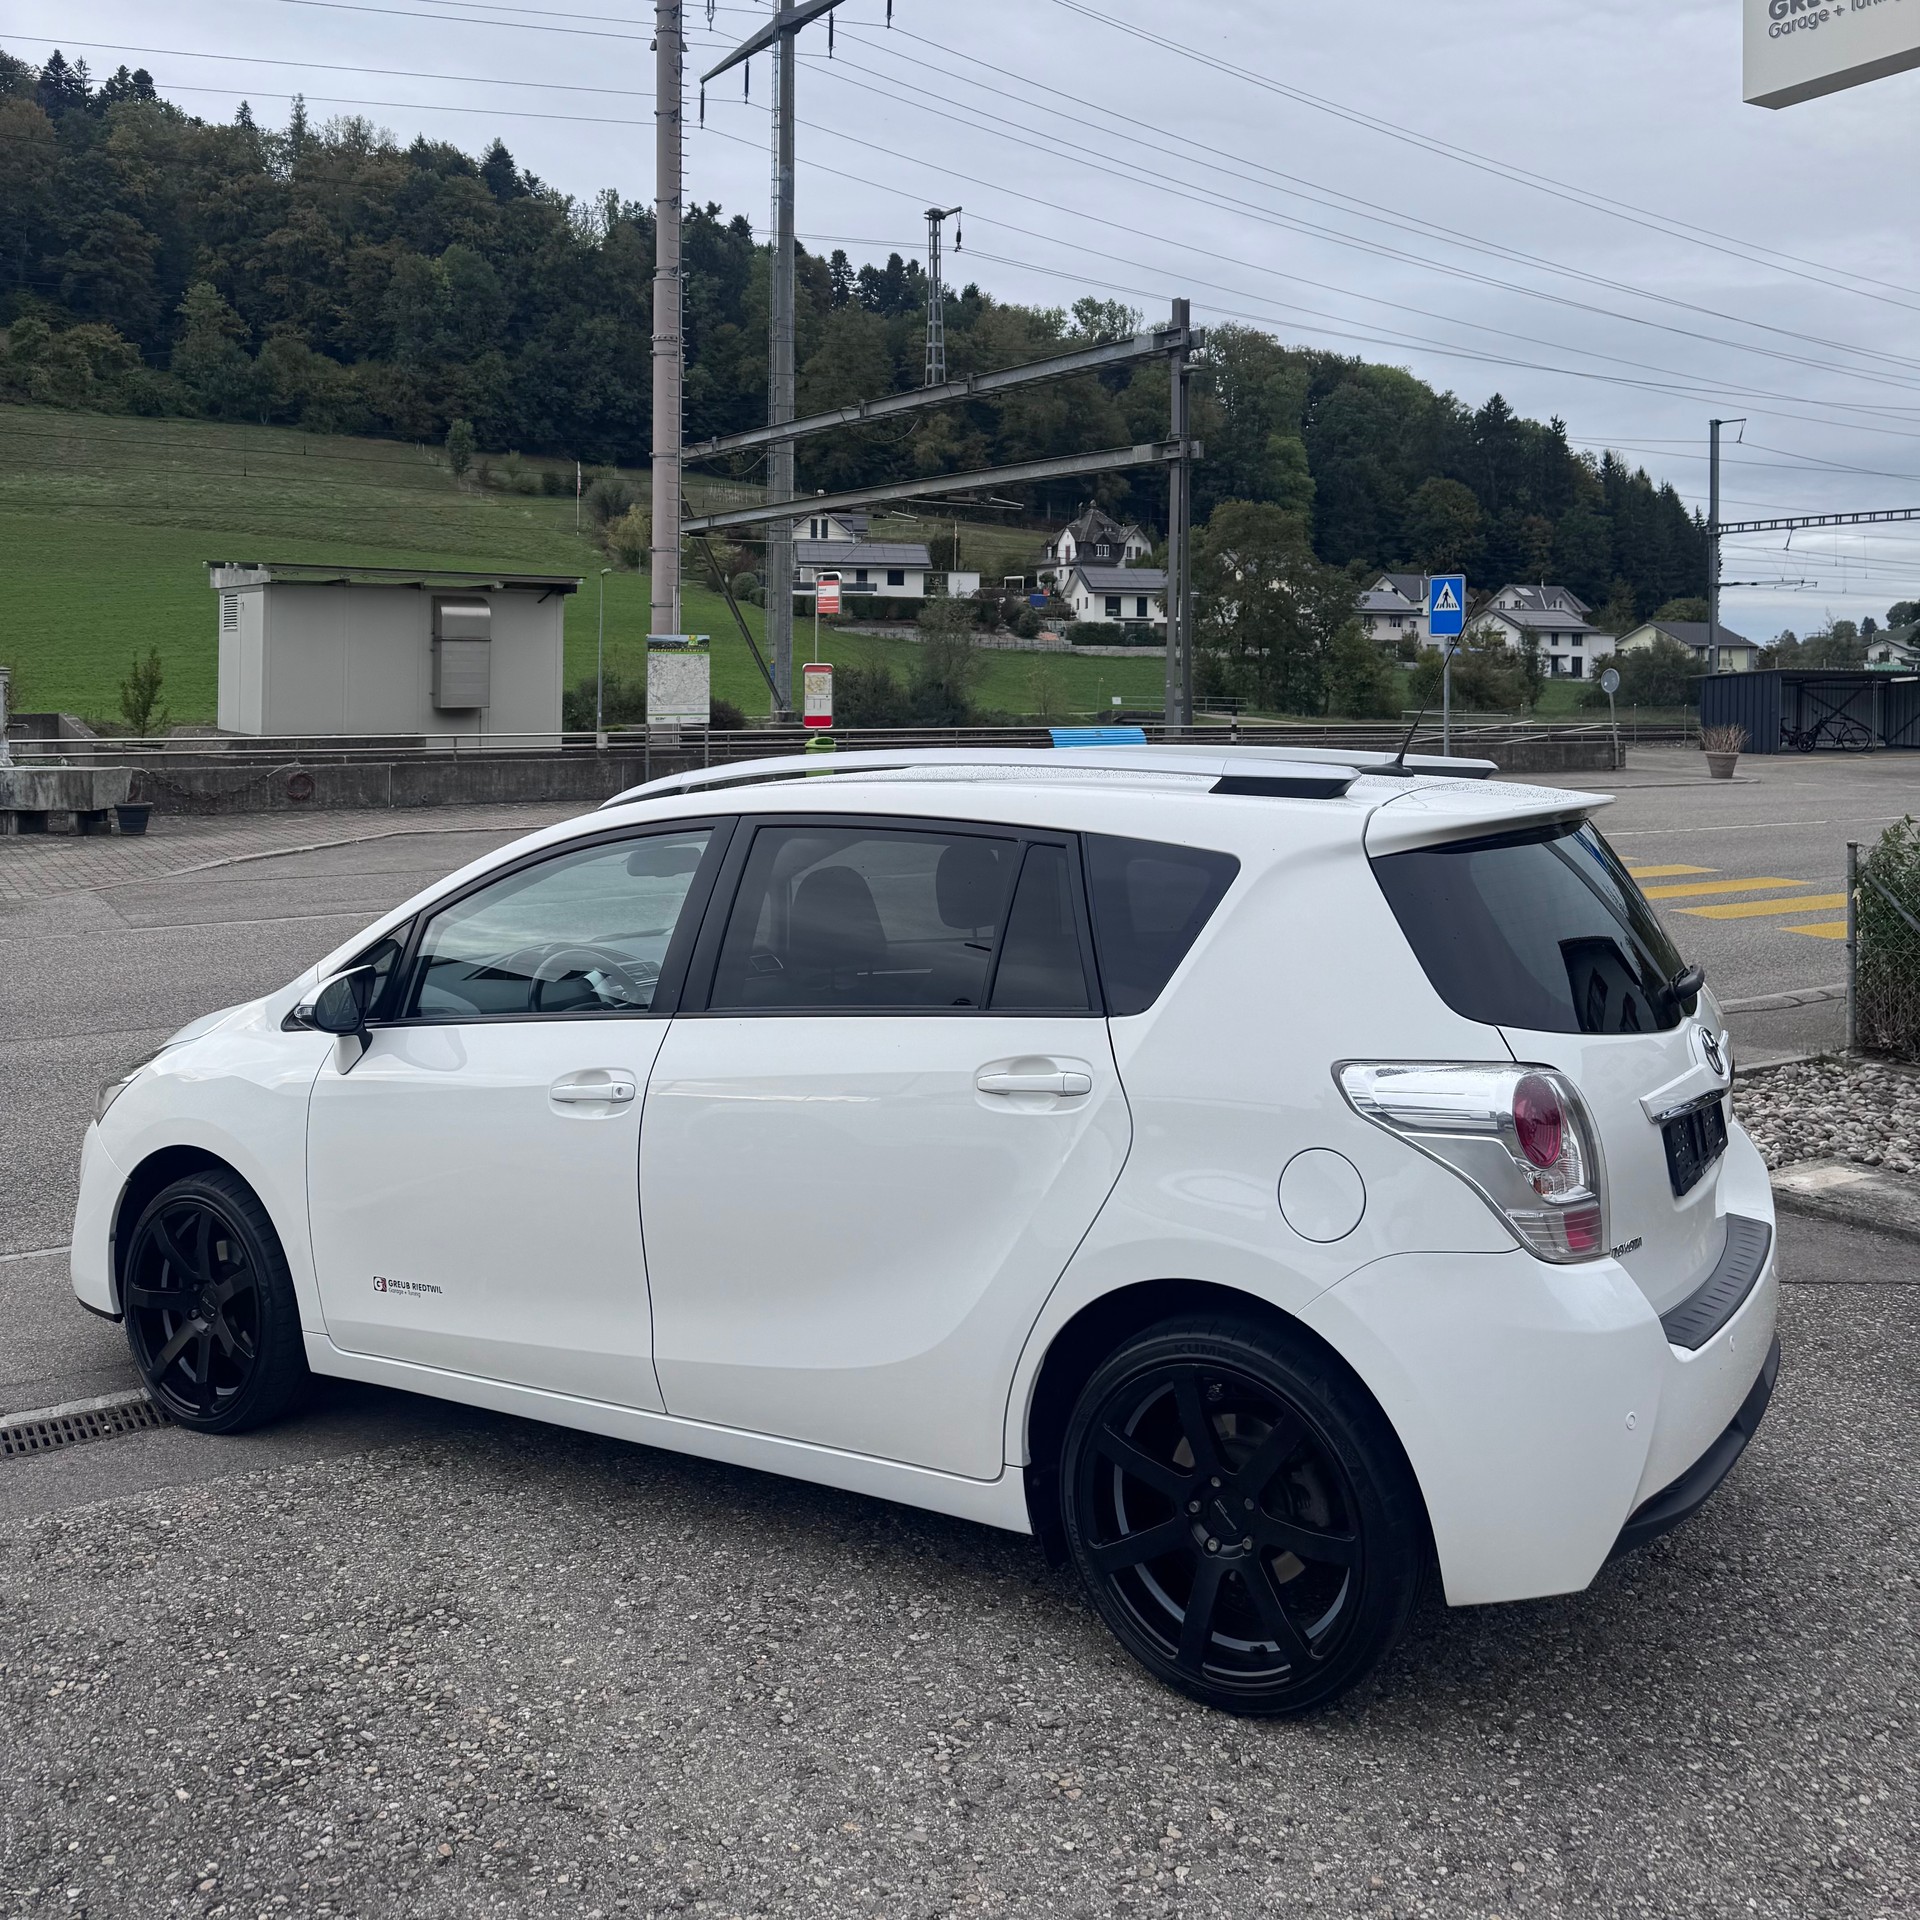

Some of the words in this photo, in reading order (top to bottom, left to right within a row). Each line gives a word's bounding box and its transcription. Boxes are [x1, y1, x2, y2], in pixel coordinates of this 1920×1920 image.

[1769, 9, 1830, 39] Garage
[388, 1279, 410, 1290] GREUB
[412, 1282, 443, 1294] RIEDTWIL
